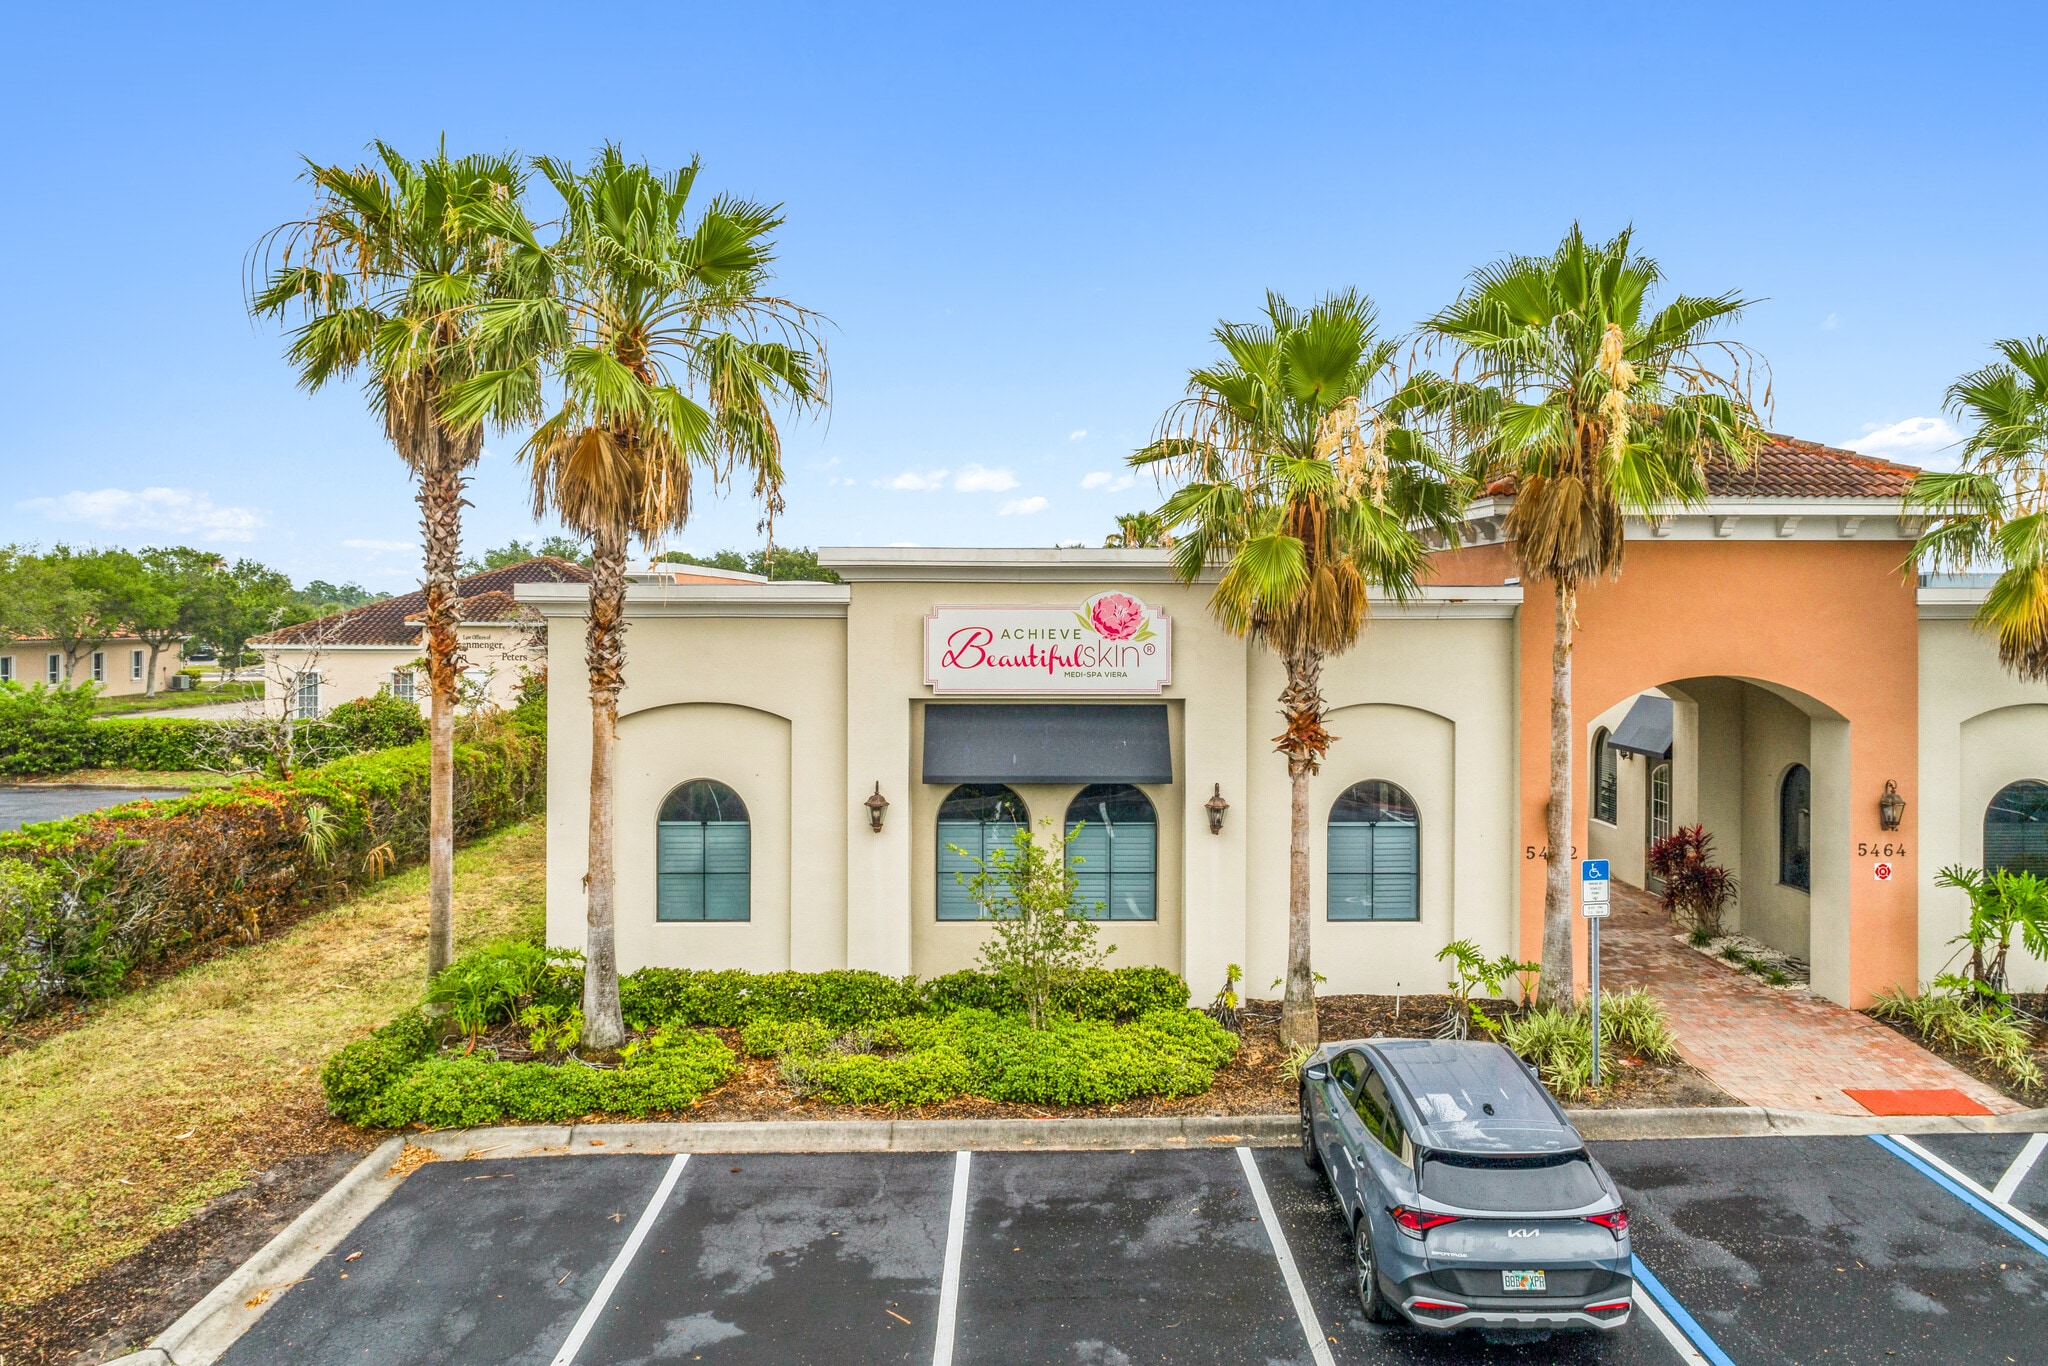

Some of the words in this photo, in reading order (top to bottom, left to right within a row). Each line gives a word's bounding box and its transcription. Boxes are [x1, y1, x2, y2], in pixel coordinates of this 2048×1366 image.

[1000, 628, 1082, 640] ACHIEVE
[501, 652, 528, 661] Peters
[1526, 845, 1578, 860] 542
[1858, 843, 1907, 857] 5464
